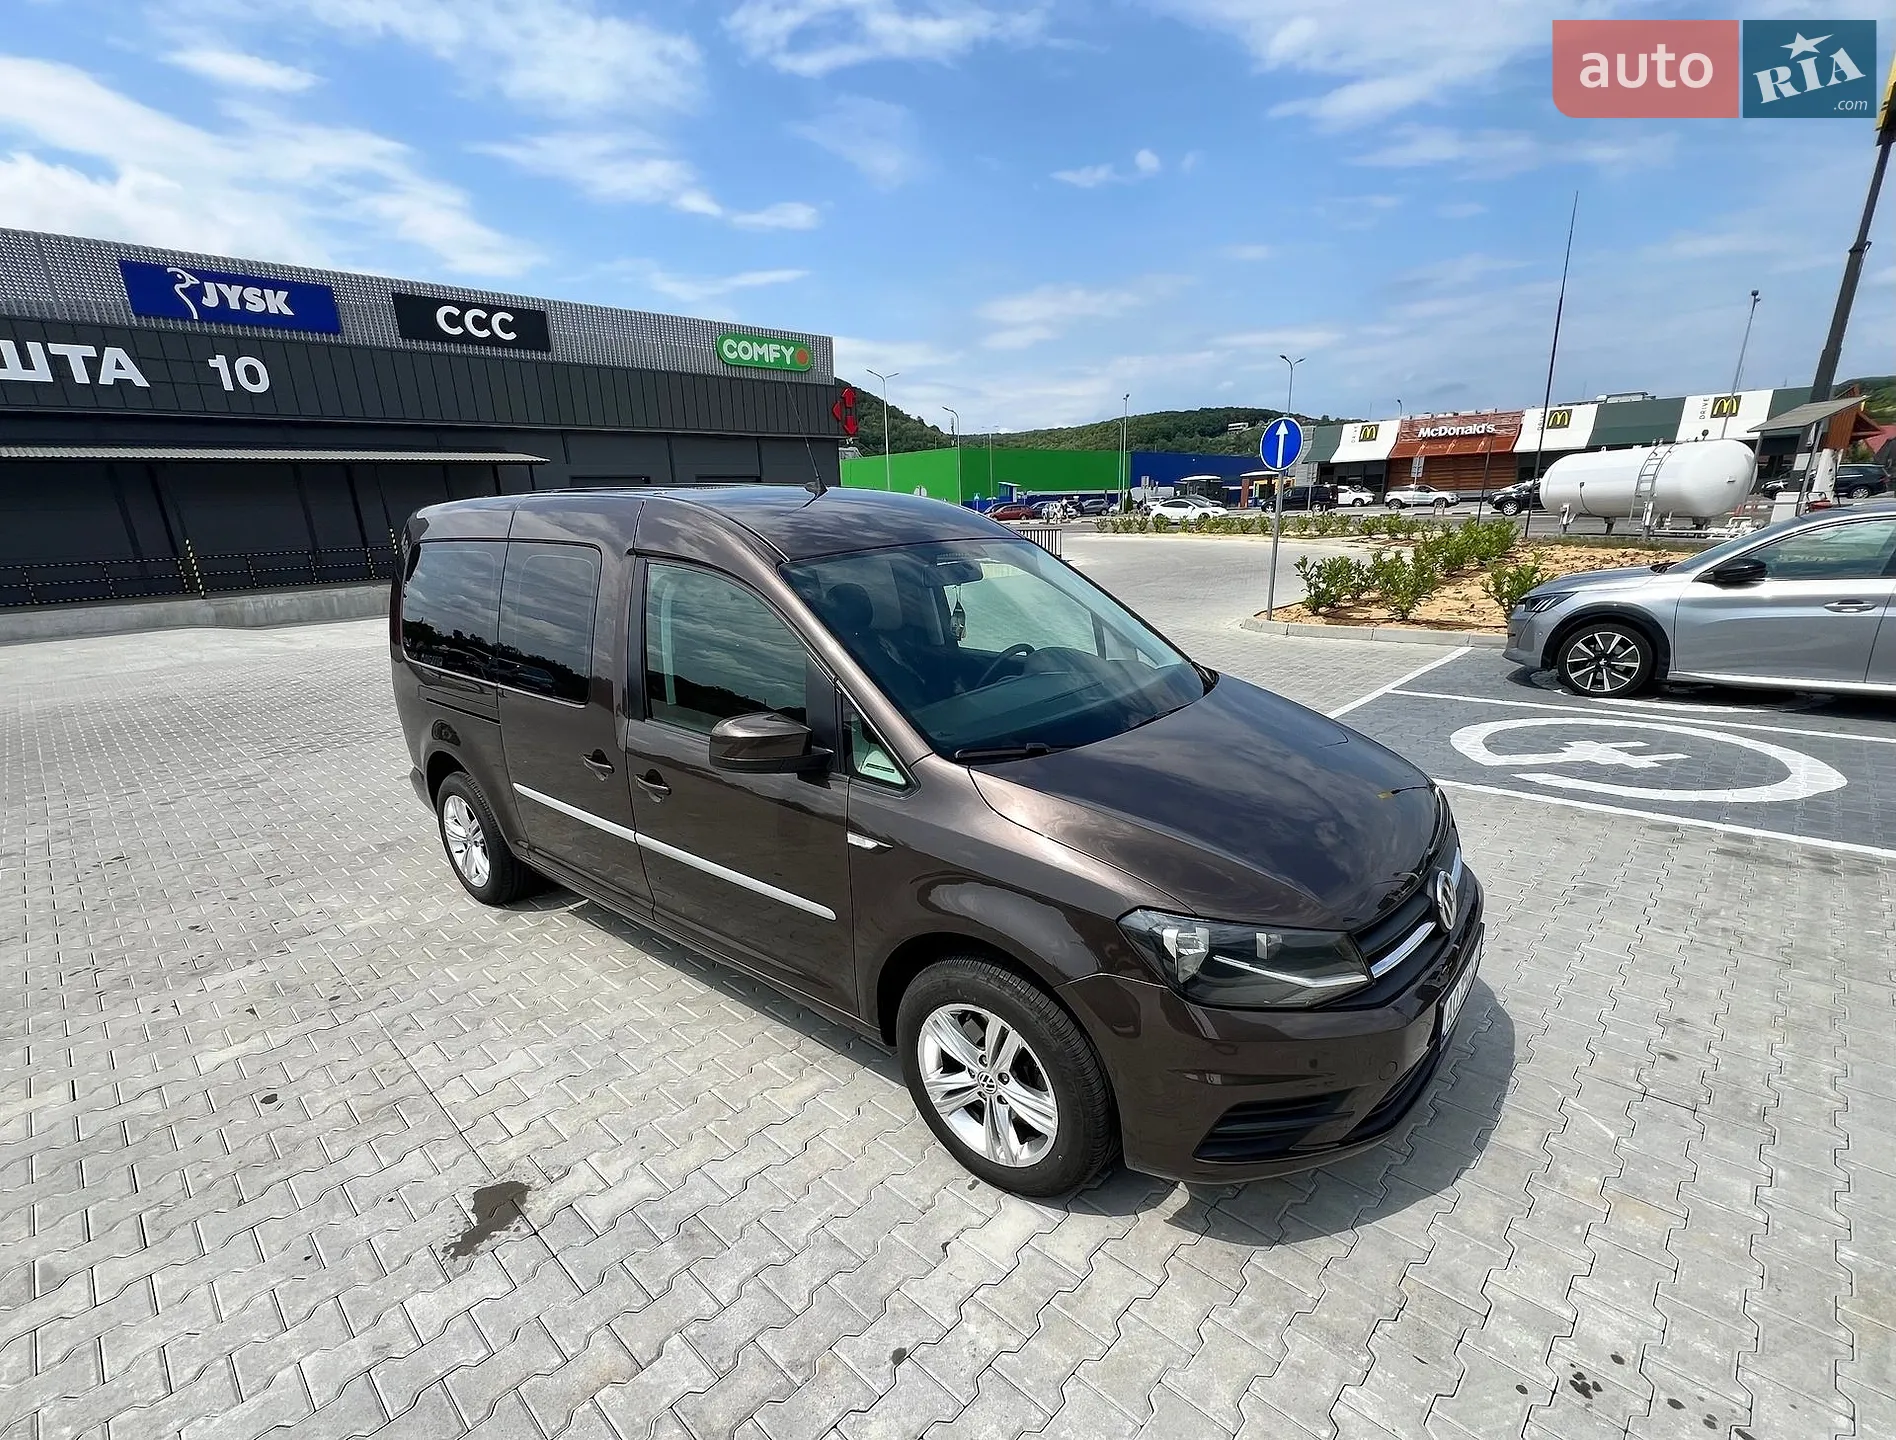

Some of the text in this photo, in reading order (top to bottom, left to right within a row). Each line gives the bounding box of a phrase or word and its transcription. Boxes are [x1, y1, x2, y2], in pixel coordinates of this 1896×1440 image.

[200, 281, 295, 316] JYSK
[435, 305, 517, 341] CCC
[722, 338, 795, 365] COMFY
[208, 354, 270, 393] 10
[1699, 397, 1710, 420] DRIVE
[1417, 423, 1496, 438] McDonald's
